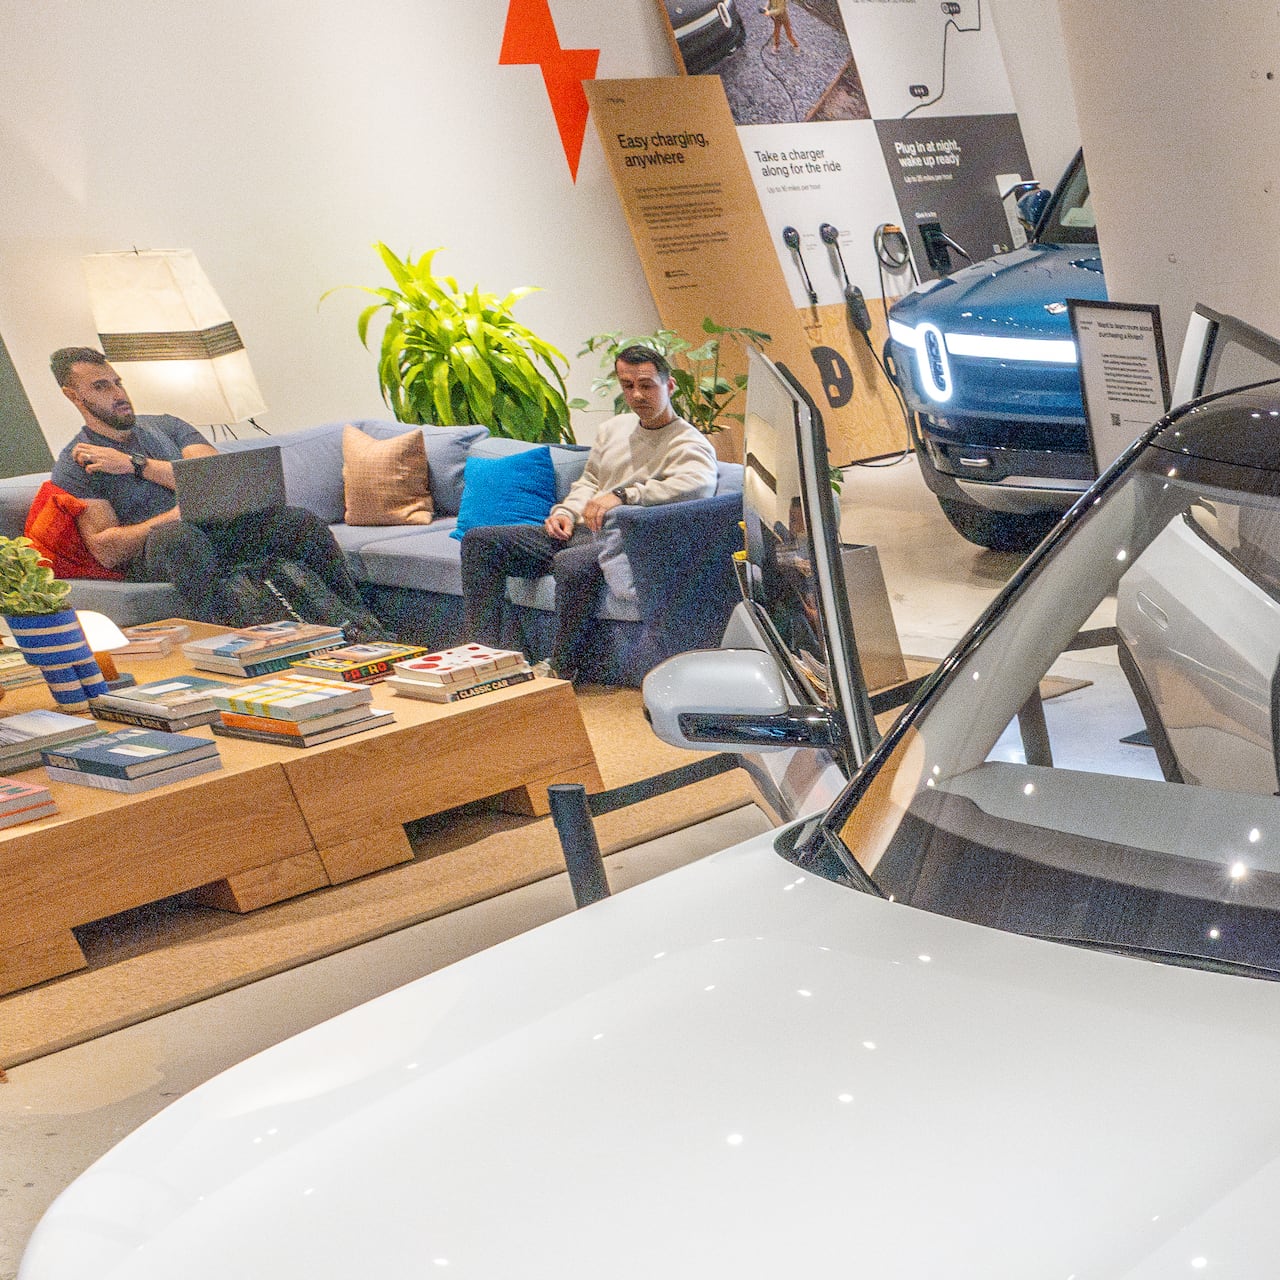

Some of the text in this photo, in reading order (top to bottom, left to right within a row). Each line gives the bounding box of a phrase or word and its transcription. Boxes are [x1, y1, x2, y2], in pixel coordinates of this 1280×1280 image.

[617, 131, 709, 150] Easy charging,
[894, 140, 961, 155] Plug in at night,
[625, 151, 685, 168] anywhere
[754, 149, 825, 163] Take a charger
[899, 153, 960, 168] wake up ready
[762, 161, 842, 178] along for the ride
[460, 679, 509, 699] CLASSIC CAR
